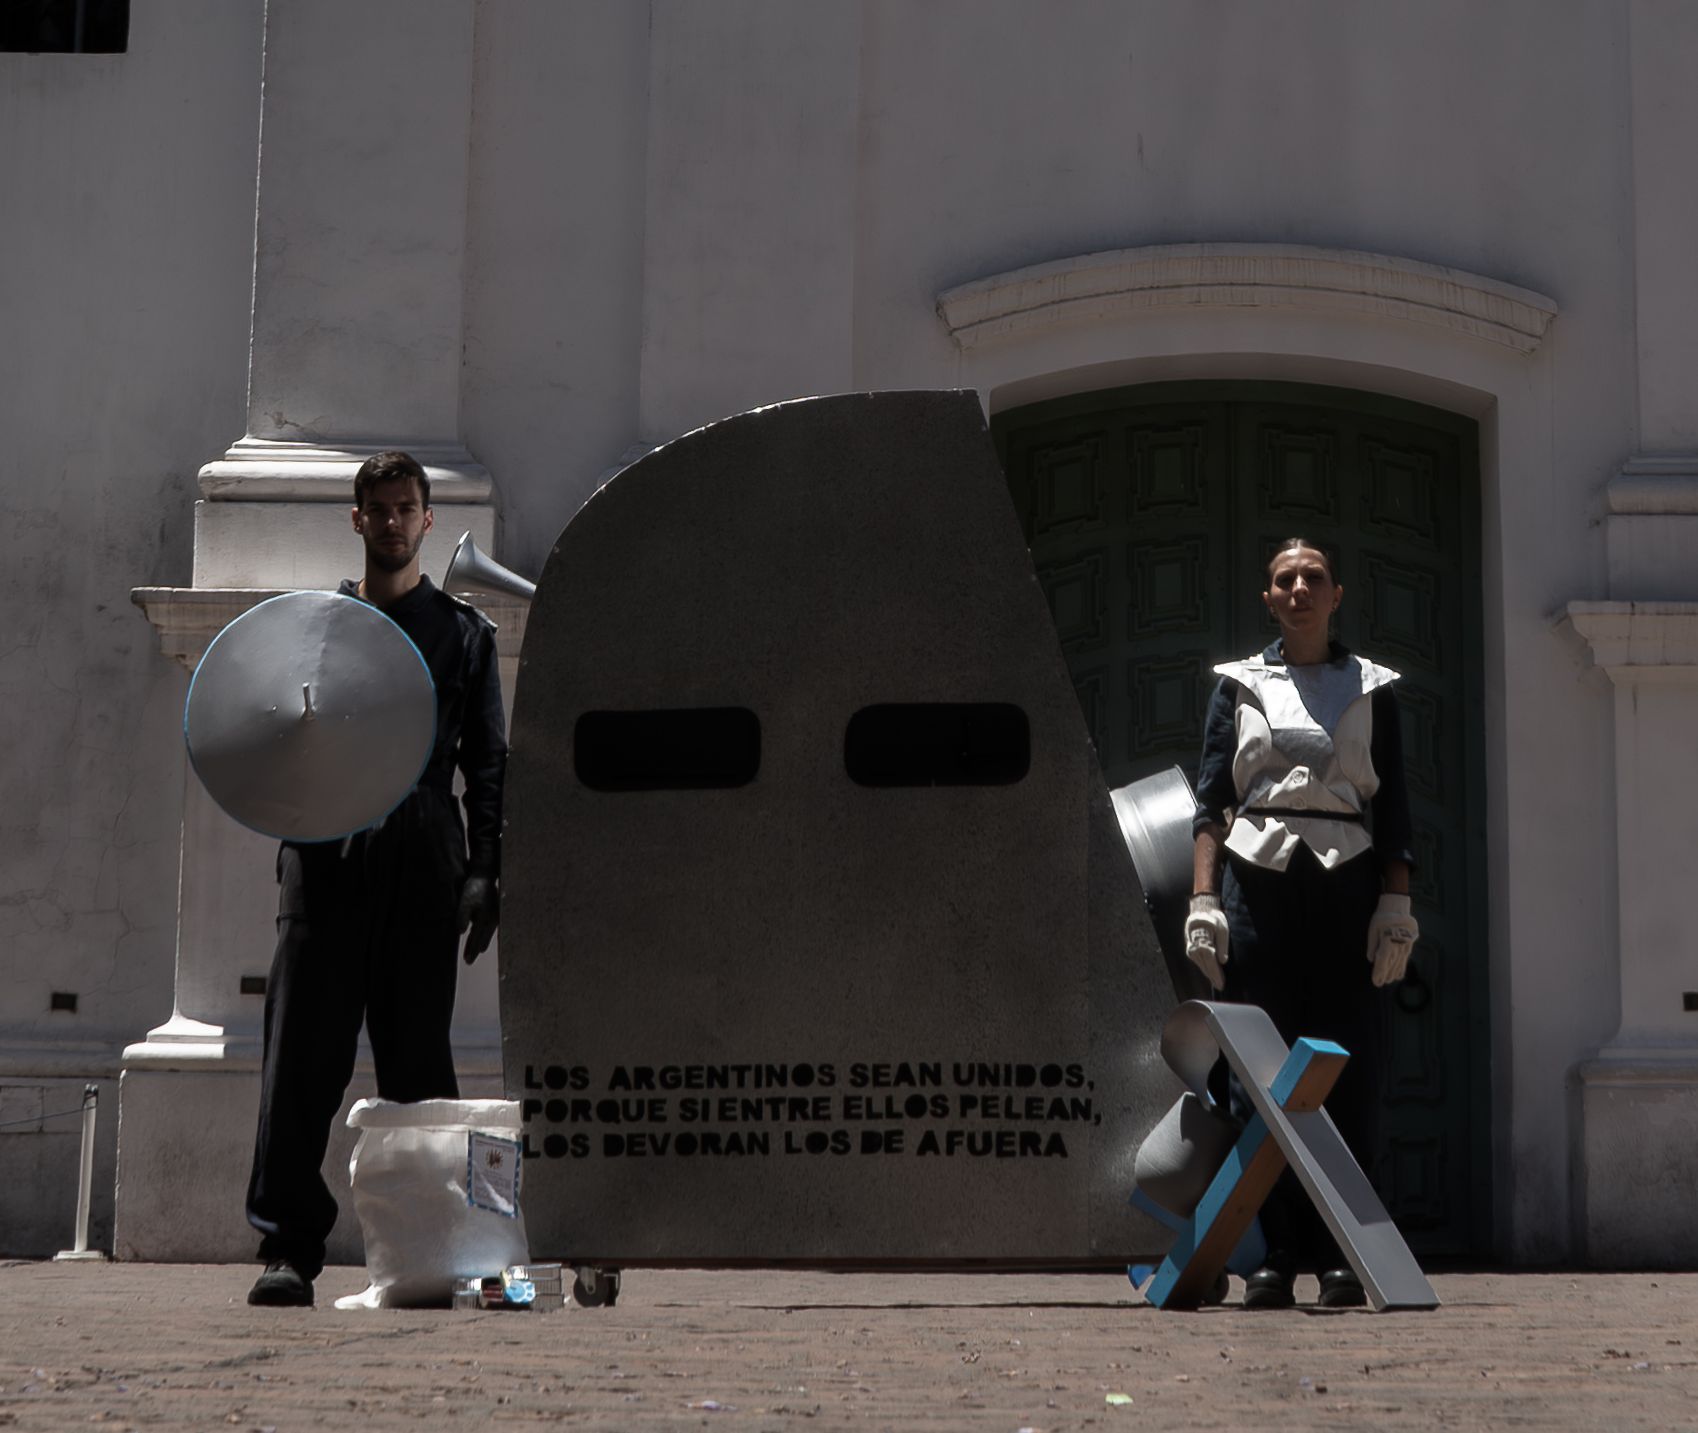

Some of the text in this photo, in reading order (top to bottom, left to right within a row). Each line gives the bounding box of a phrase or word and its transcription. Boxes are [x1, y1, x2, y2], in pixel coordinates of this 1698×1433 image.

[525, 1062, 1095, 1092] LOS ARGENTINOS SEAN UNIDOS,
[523, 1093, 1102, 1126] PORQUE SI ENTRE ELLOS PELEAN,
[522, 1132, 591, 1159] LOS
[603, 1131, 770, 1158] DEVORAN
[784, 1129, 851, 1156] LOS
[860, 1129, 904, 1155] DE
[916, 1130, 1068, 1159] AFUERA
